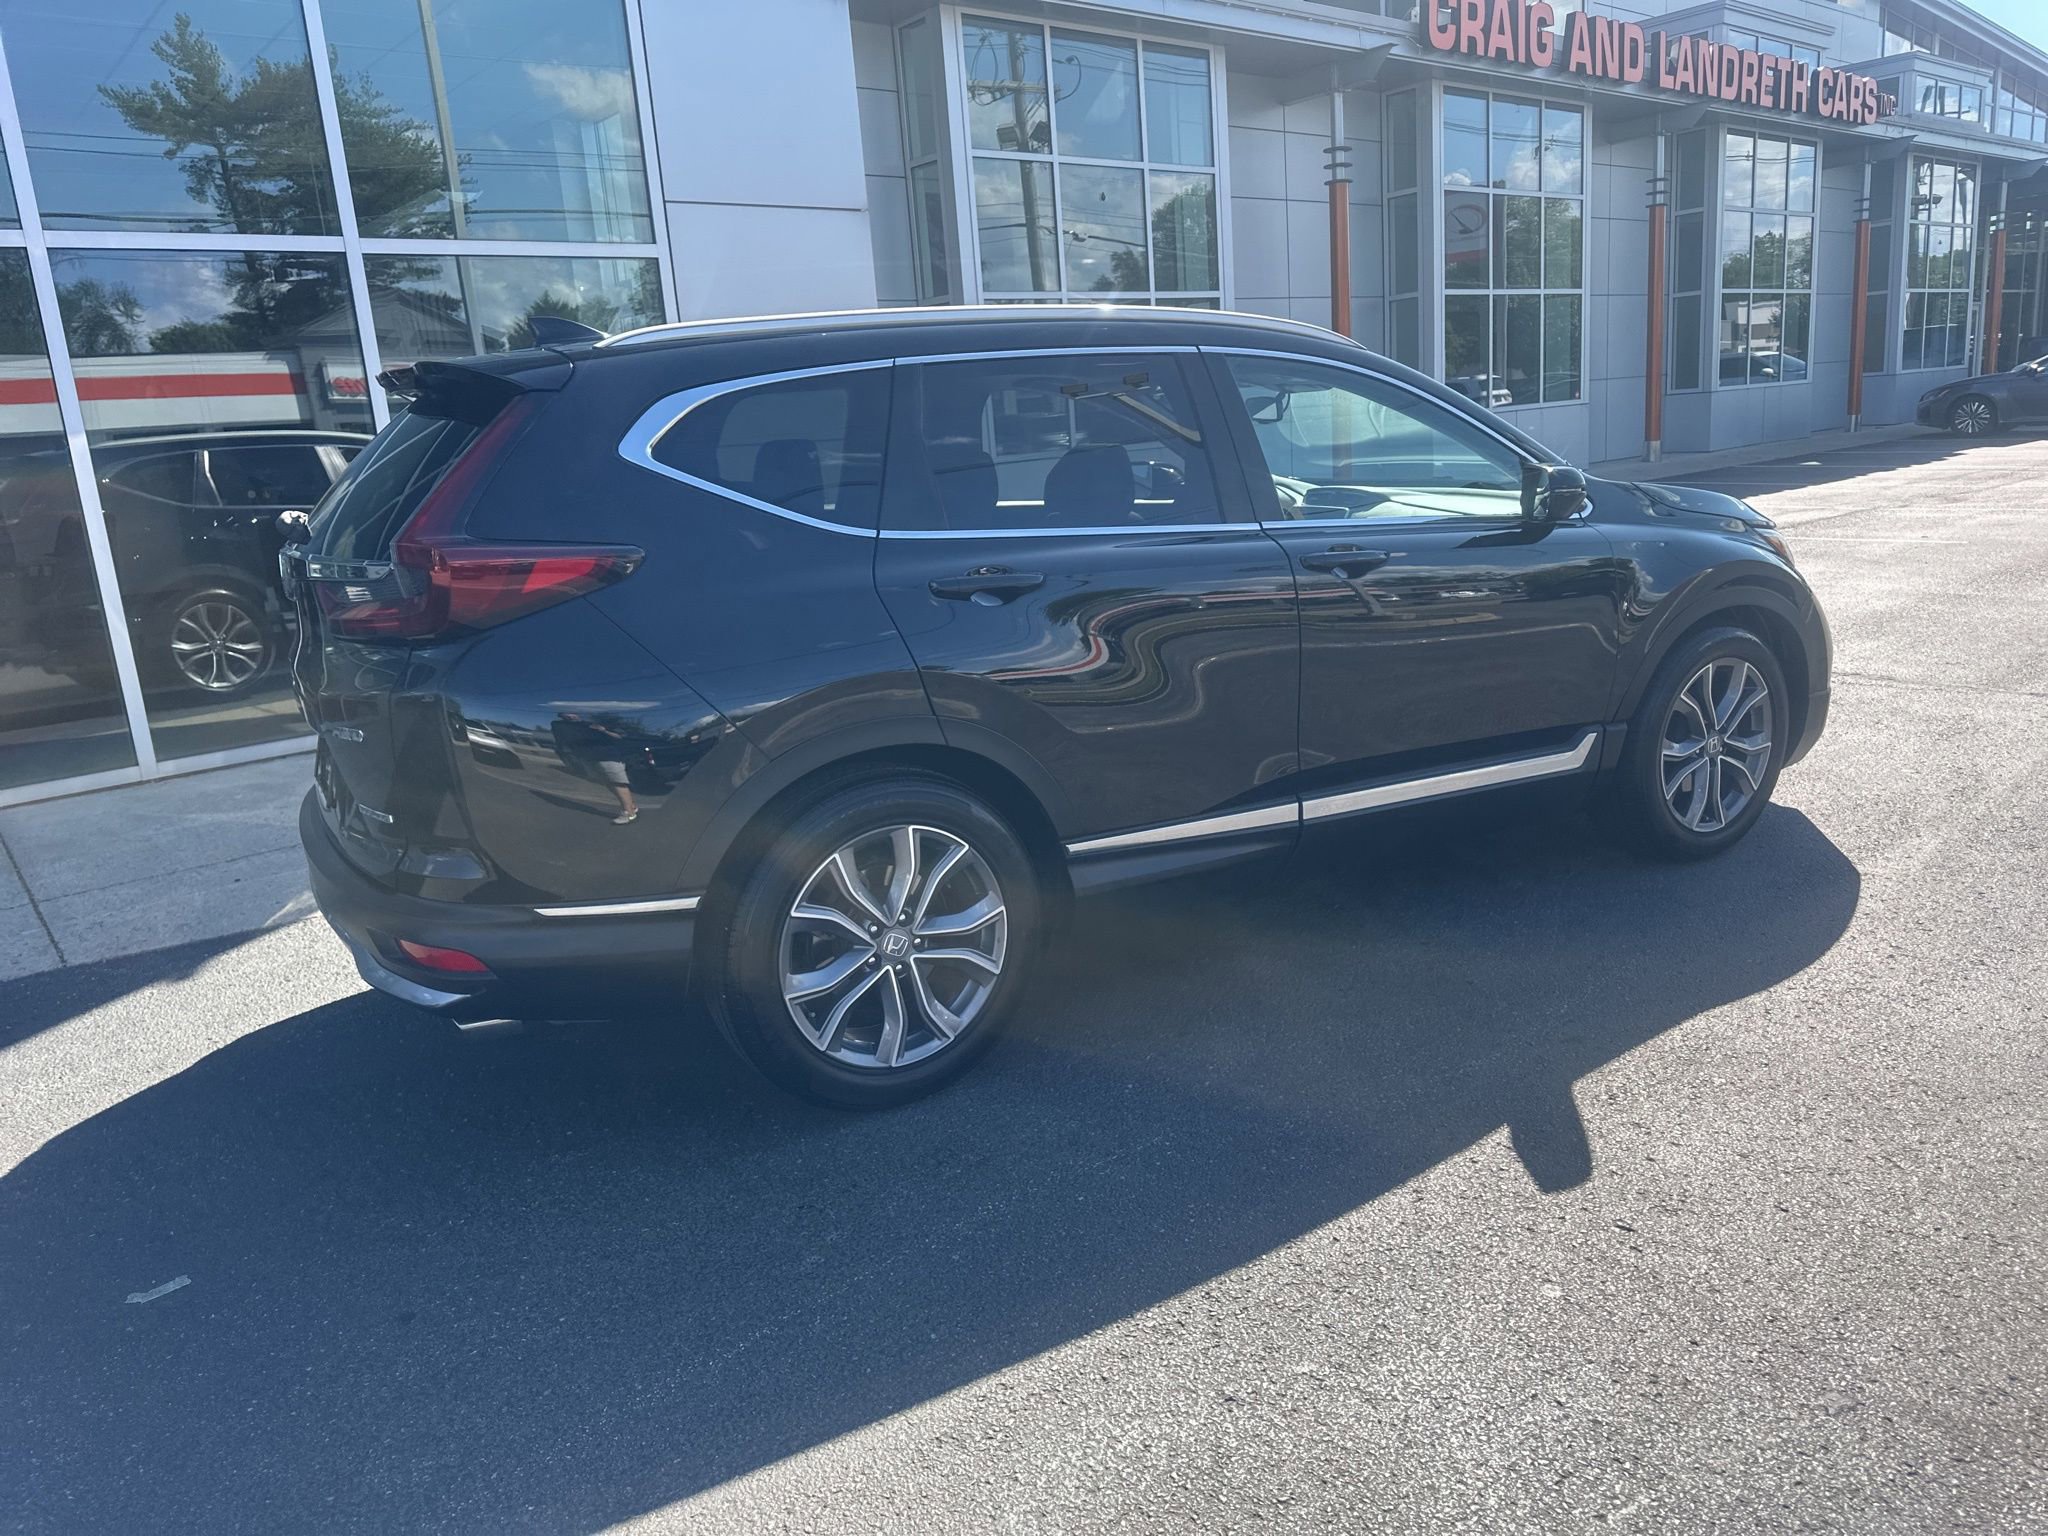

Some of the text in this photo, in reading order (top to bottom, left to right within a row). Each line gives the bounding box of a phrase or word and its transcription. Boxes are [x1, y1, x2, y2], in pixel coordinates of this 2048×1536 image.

[1428, 0, 1554, 68] CRAIG
[1569, 11, 1645, 82] AND
[1659, 31, 1809, 112] LANDRETH
[1818, 66, 1878, 125] CARS
